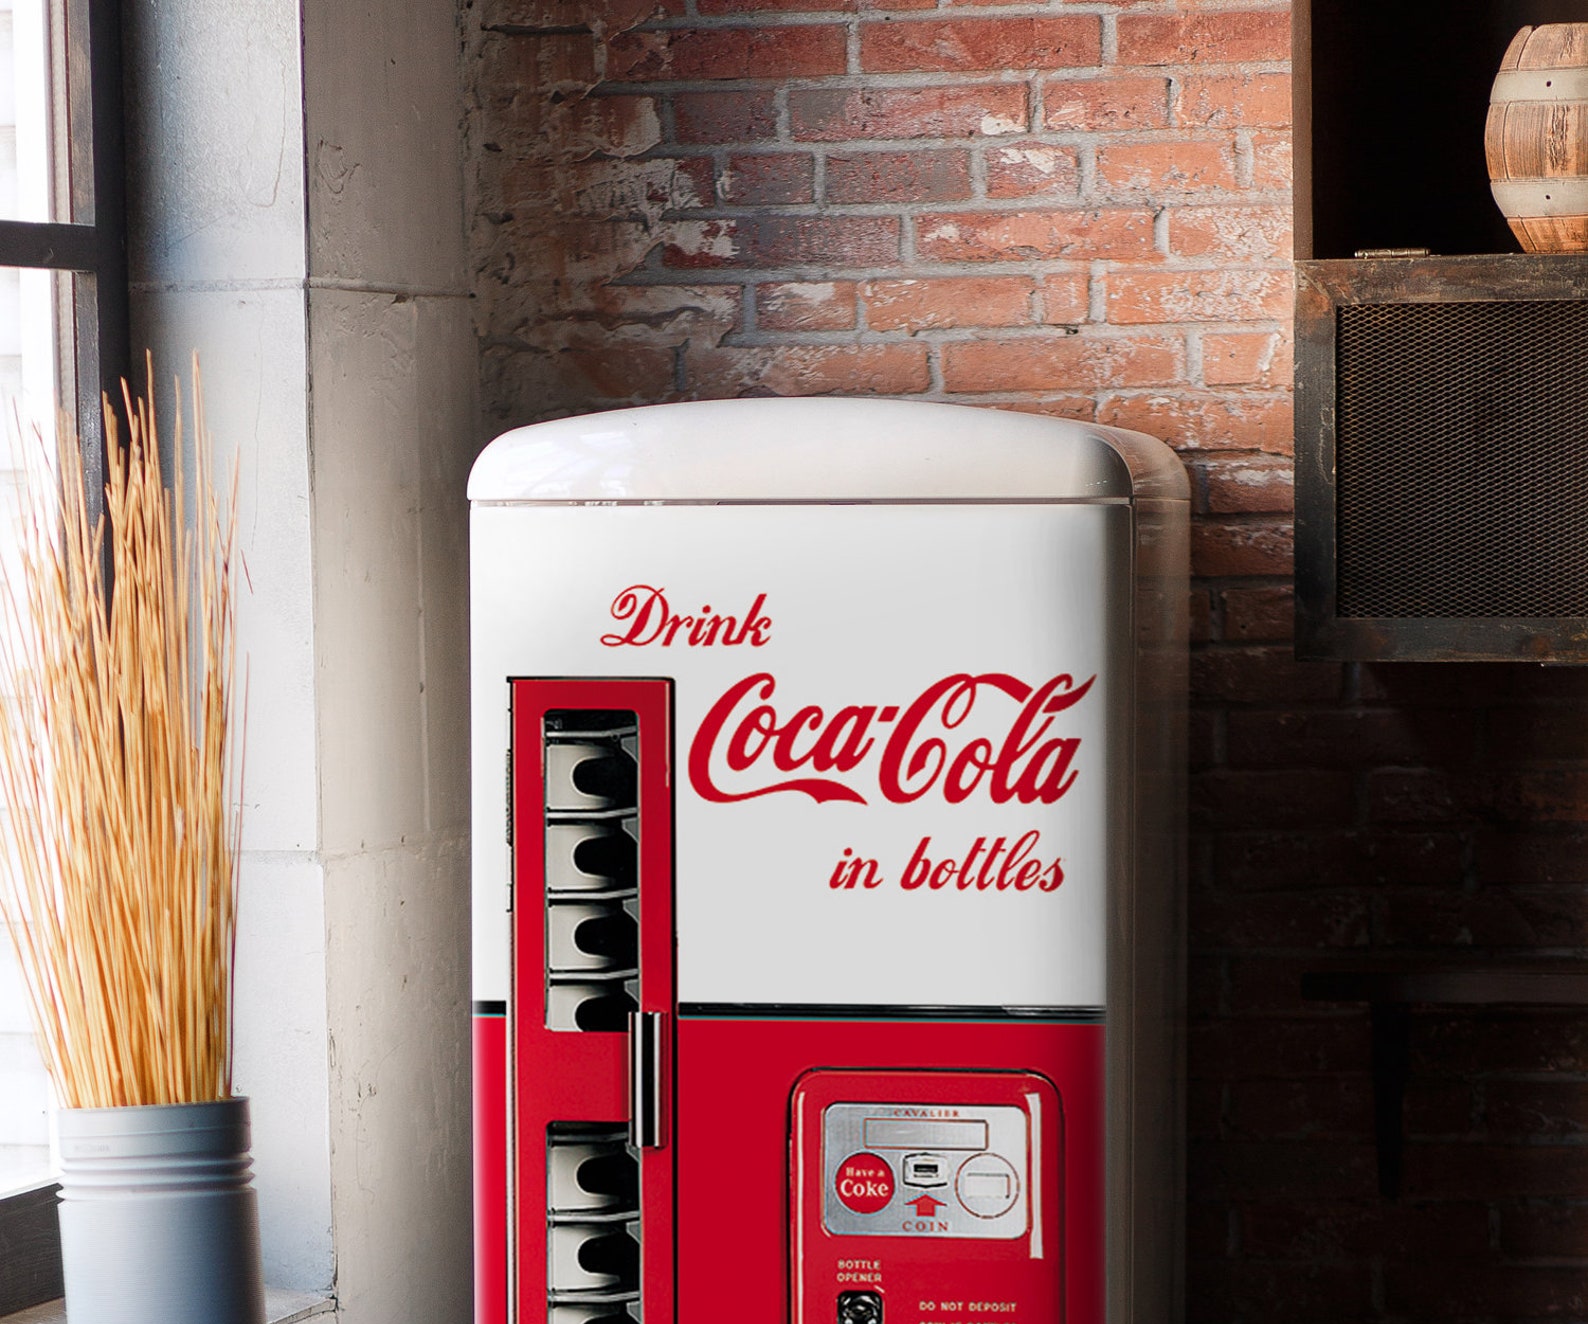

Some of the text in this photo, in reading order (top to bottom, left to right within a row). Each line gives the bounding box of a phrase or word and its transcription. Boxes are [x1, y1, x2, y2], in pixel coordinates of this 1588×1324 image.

[600, 584, 772, 647] Drink
[688, 672, 1097, 806] Coca-Cola
[829, 830, 1065, 892] in bottles
[893, 1109, 960, 1118] CAVALIER
[846, 1167, 876, 1177] Have
[840, 1179, 889, 1197] Coke
[902, 1221, 950, 1232] COIN
[838, 1259, 881, 1270] BOTTLE
[837, 1272, 882, 1283] OPENER
[919, 1301, 1016, 1312] DO NOT DEPOSIT
